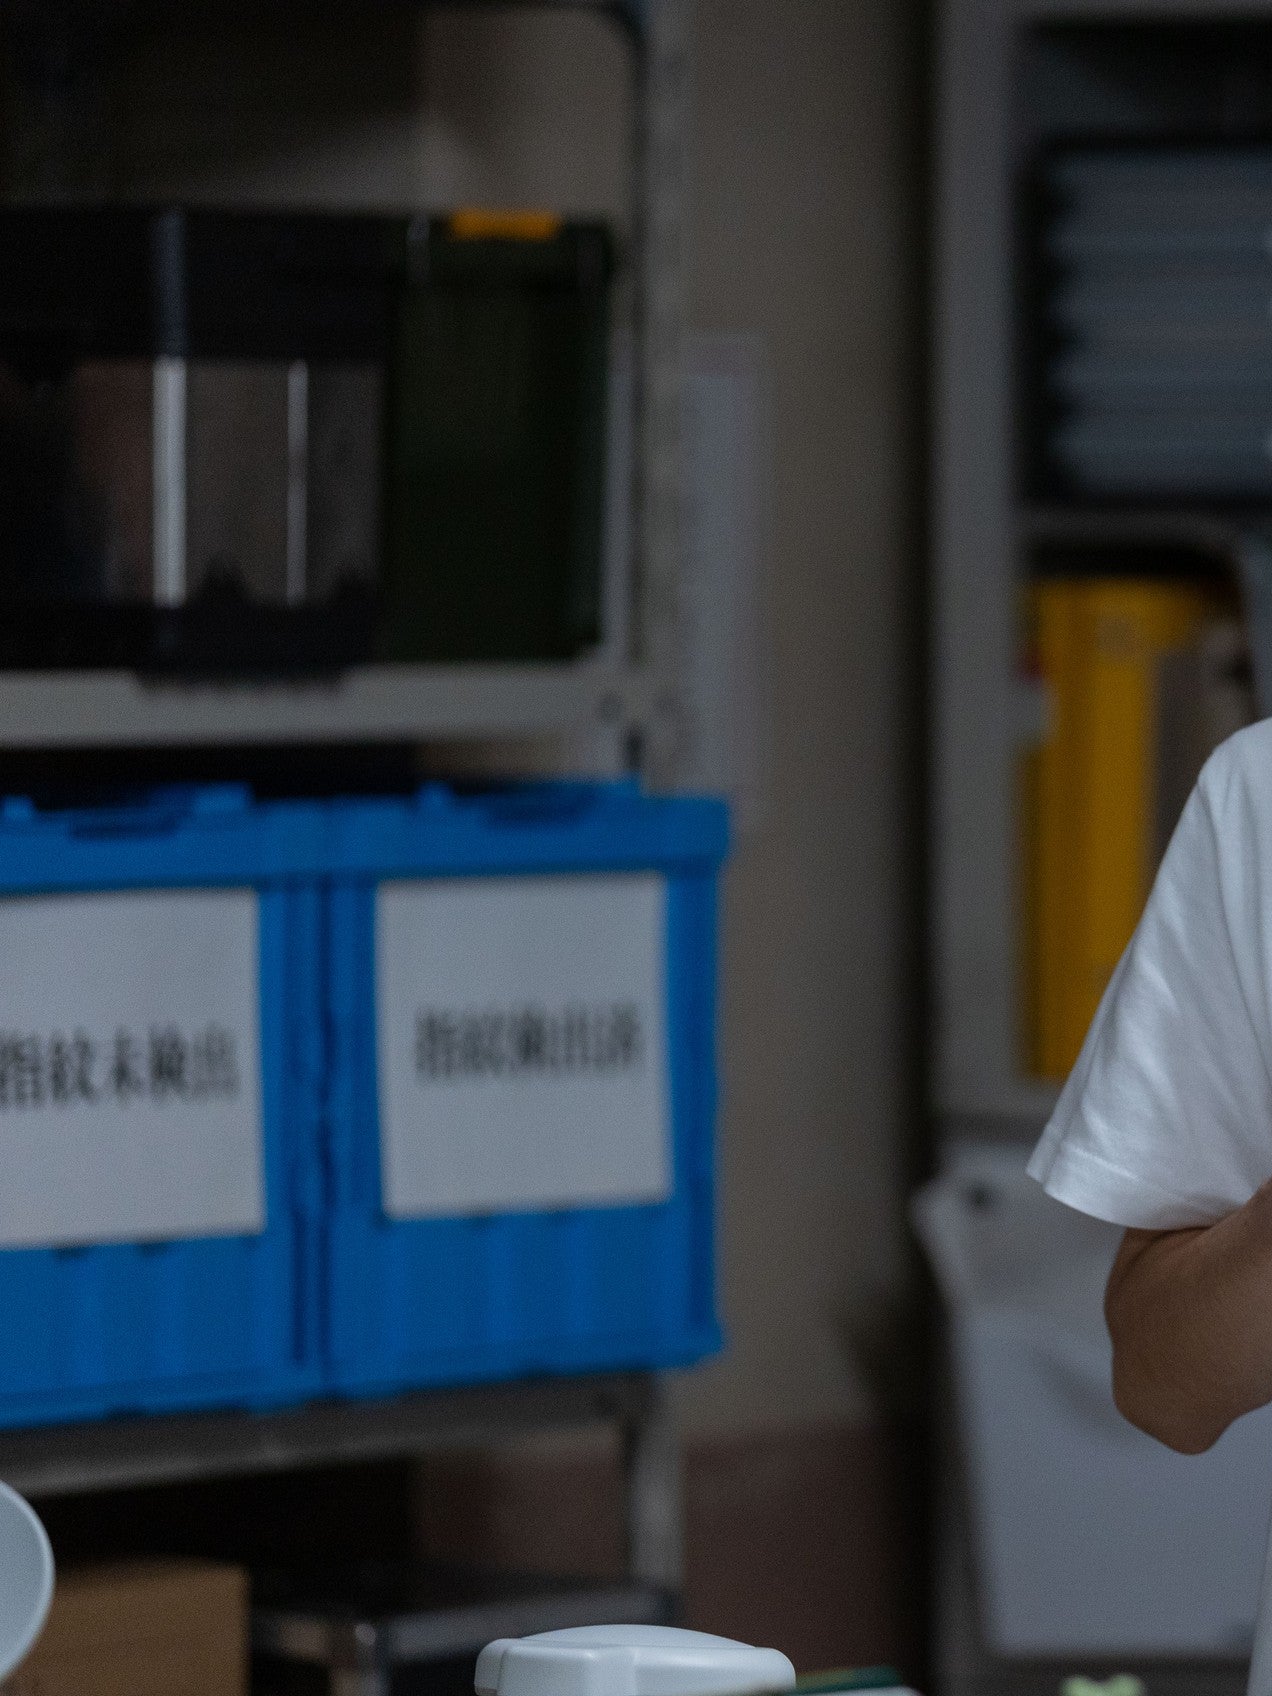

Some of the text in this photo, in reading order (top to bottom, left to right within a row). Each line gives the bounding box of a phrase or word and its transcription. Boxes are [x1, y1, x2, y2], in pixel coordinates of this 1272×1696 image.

[0, 1022, 242, 1111] 指紋未検出
